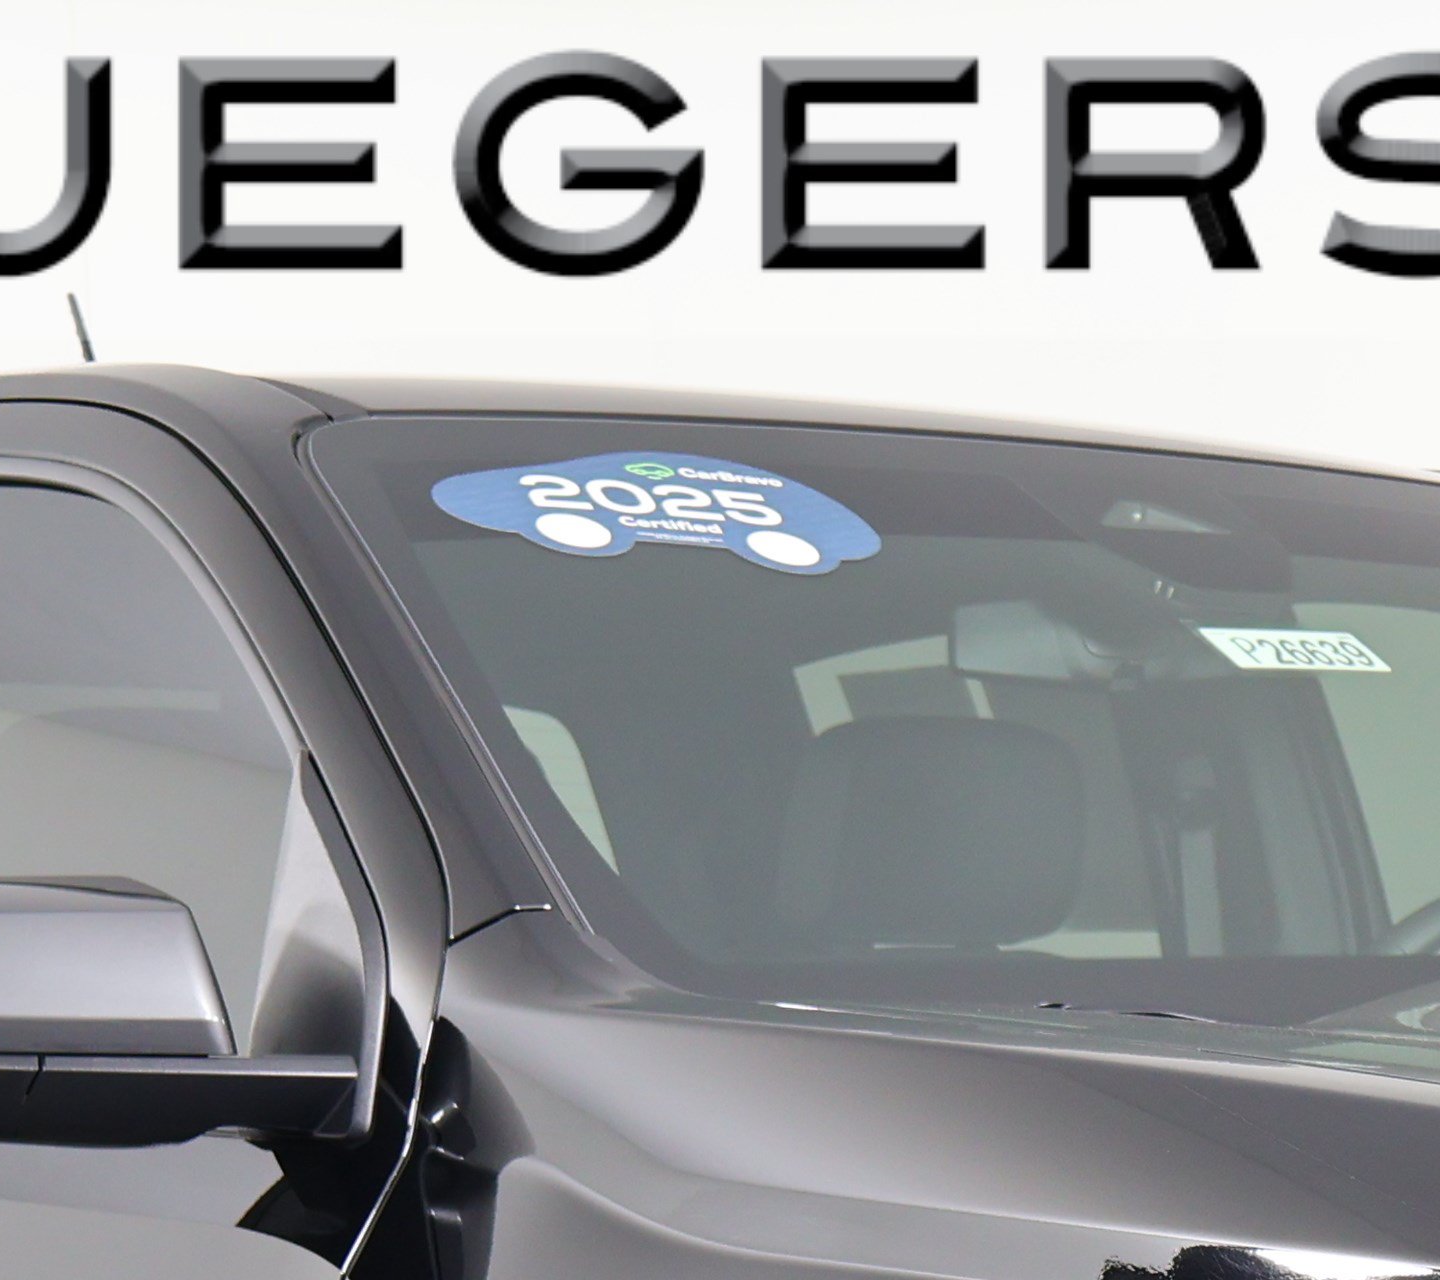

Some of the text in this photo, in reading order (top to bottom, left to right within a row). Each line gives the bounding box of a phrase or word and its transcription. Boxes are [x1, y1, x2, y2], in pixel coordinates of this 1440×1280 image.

[677, 466, 783, 489] CarBravo
[519, 474, 782, 526] 2025
[618, 515, 724, 535] Certified
[1231, 636, 1375, 667] P26639
